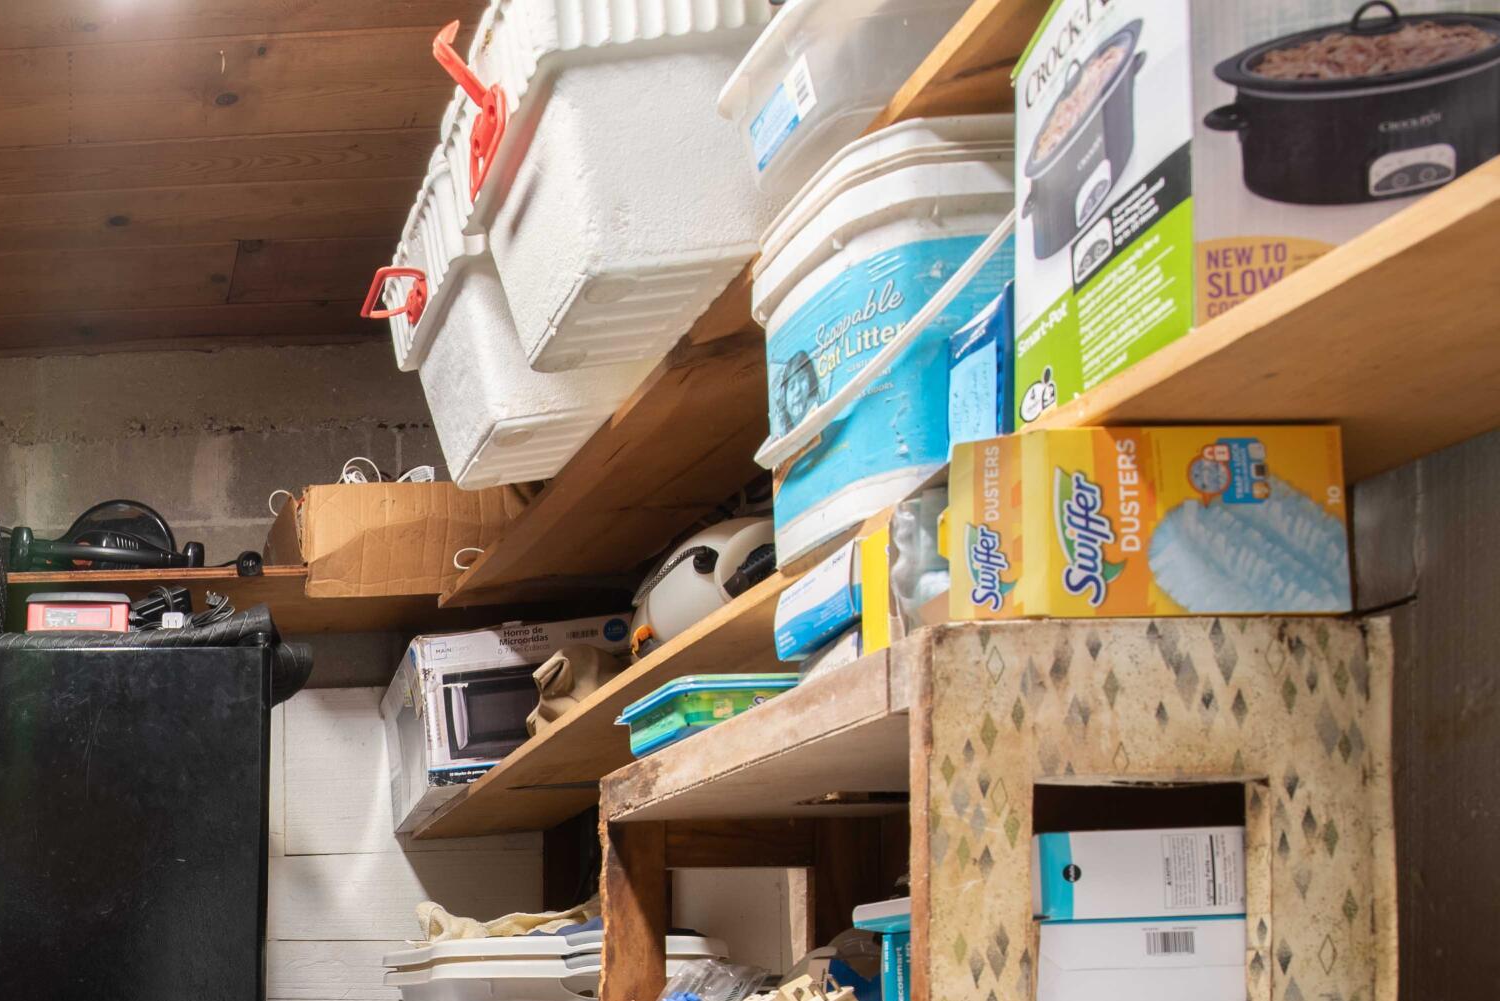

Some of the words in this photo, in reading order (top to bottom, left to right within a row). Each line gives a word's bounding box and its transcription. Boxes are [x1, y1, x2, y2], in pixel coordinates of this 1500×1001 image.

[1206, 245, 1254, 270] NEW
[1262, 242, 1288, 265] TO
[1207, 267, 1285, 299] SLOW
[814, 279, 906, 356] Scoopable
[816, 344, 842, 379] Cat
[844, 318, 910, 358] Litter
[983, 445, 1001, 522] DUSTERS
[1115, 438, 1141, 554] DUSTERS
[971, 524, 1009, 610] Swiffer
[1064, 473, 1114, 607] Swiffer
[532, 626, 543, 635] de
